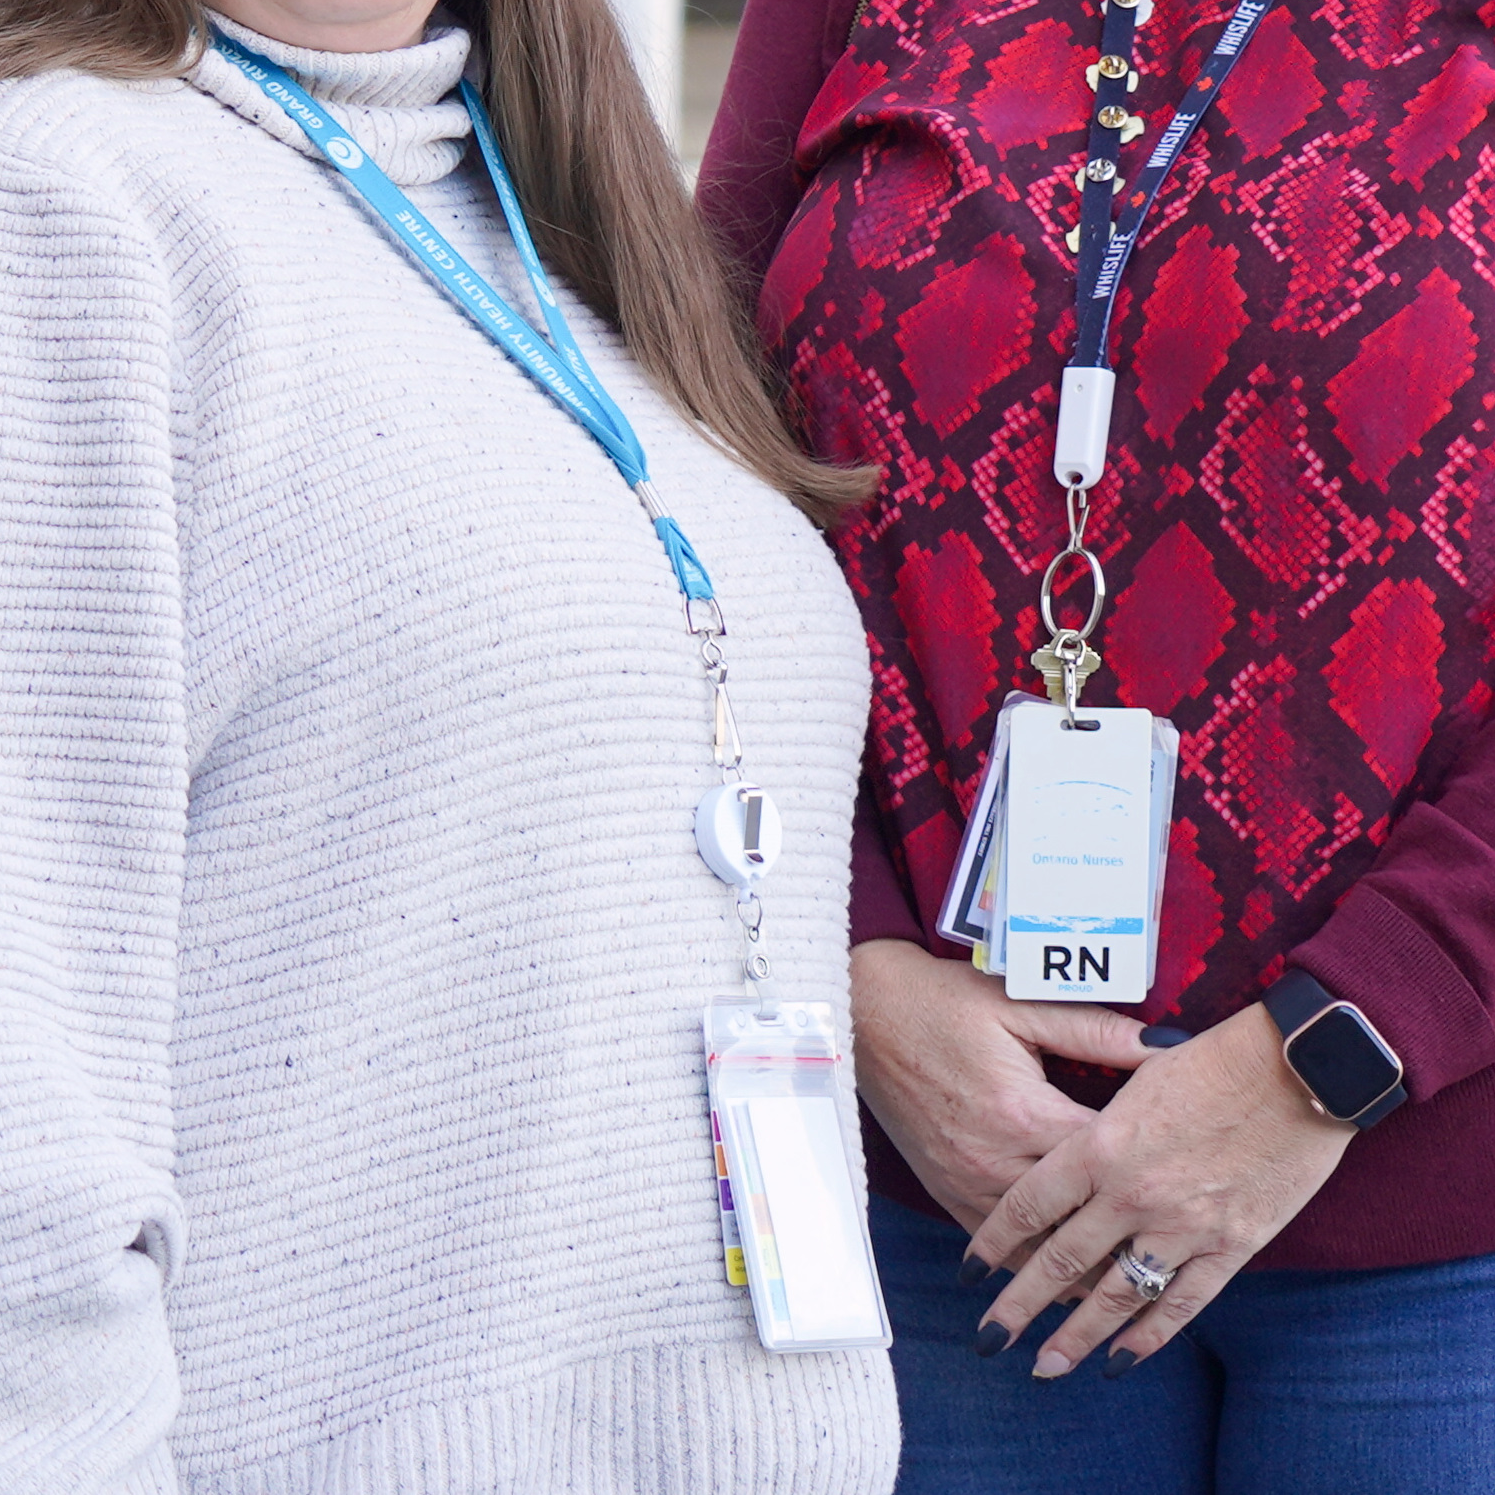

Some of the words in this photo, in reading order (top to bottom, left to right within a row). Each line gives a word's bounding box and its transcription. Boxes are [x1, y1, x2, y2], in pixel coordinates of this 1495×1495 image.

[1213, 0, 1266, 56] WHISLIFE
[266, 81, 314, 130] GRAND
[1146, 112, 1197, 168] WHISLIFE
[395, 209, 455, 271] CENTRE
[1092, 230, 1135, 300] WHISLIFE
[453, 271, 514, 331] HEALTH
[1032, 853, 1079, 865] Ontario
[1083, 854, 1124, 867] Nurses
[1043, 945, 1110, 982] RN
